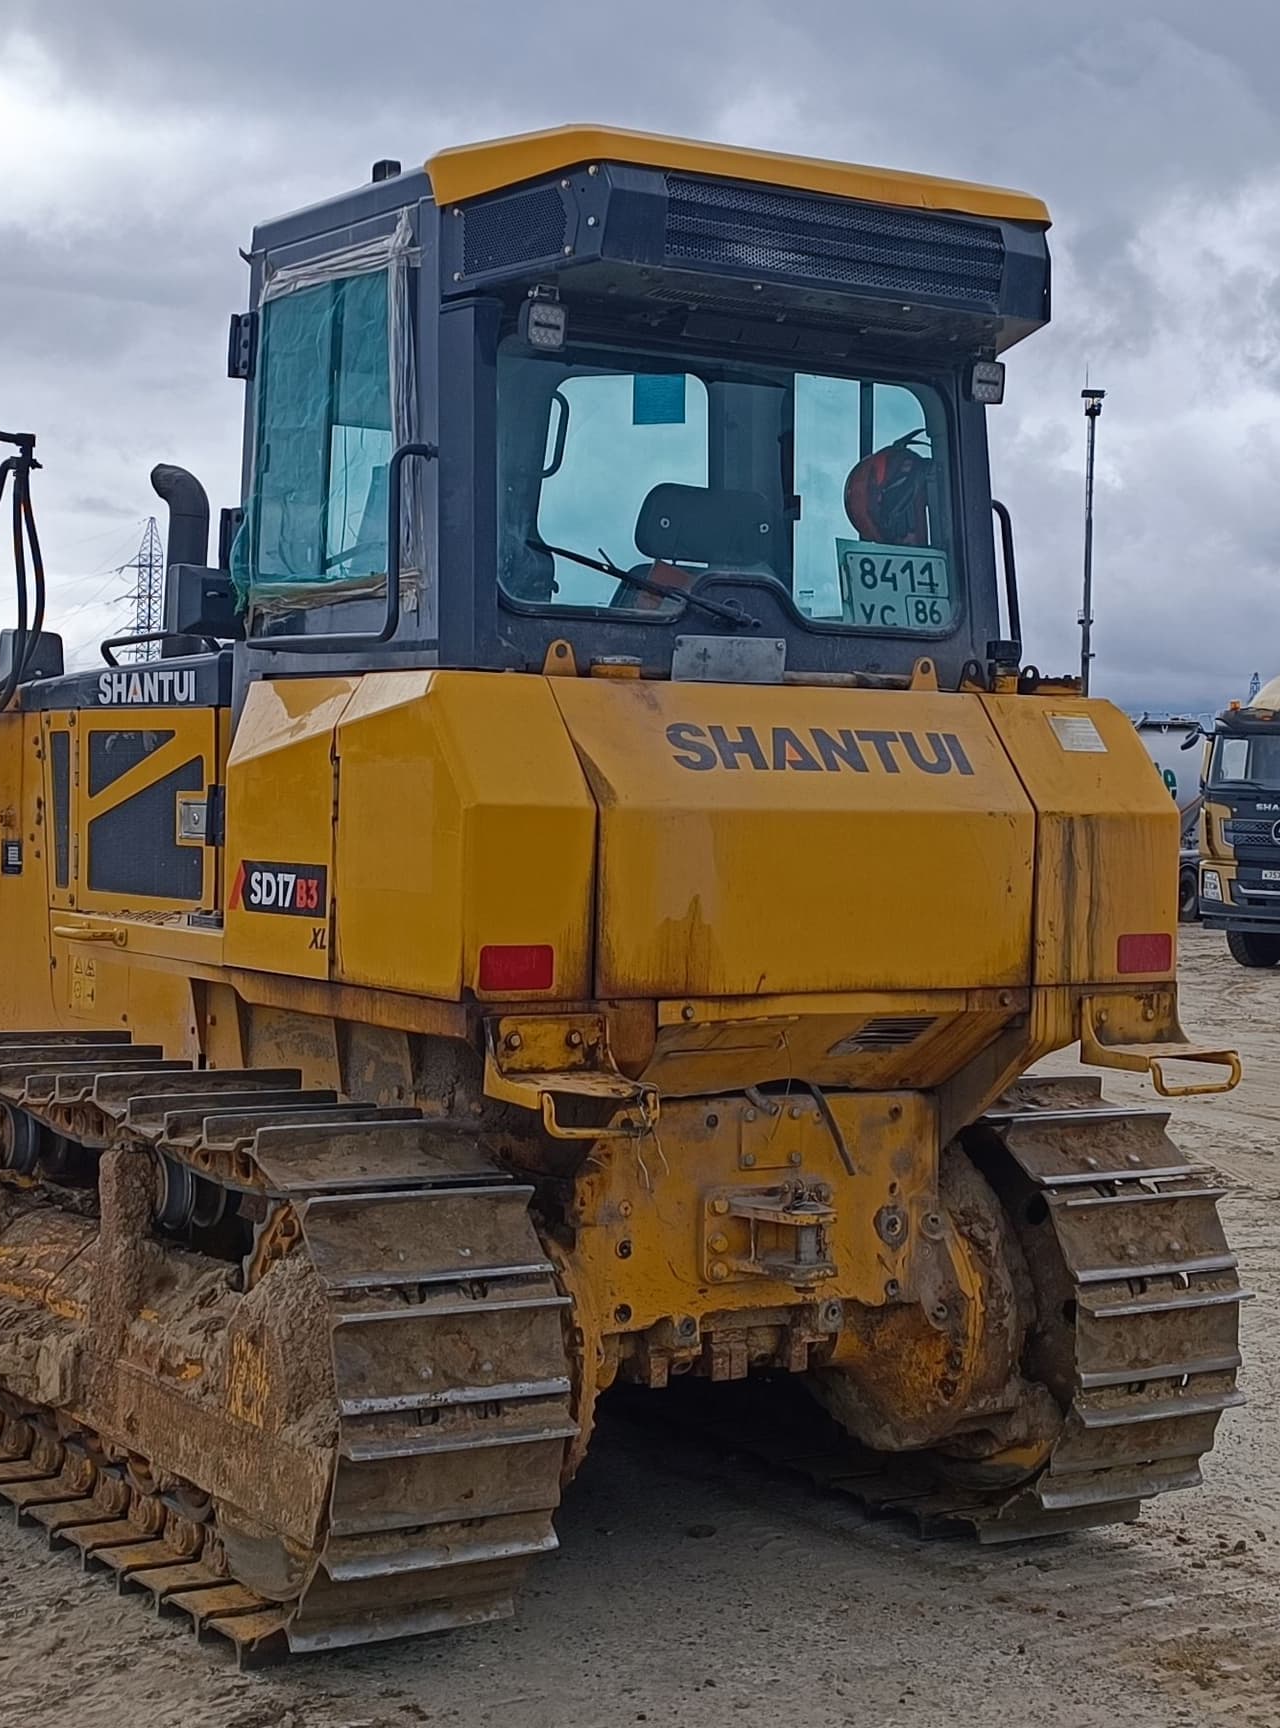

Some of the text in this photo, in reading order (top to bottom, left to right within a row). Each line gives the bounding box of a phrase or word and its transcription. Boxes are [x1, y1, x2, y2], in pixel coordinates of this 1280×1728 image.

[915, 600, 942, 624] 86
[98, 671, 195, 704] SHANTUI
[666, 722, 975, 775] SHANTUI
[309, 928, 326, 949] XL
